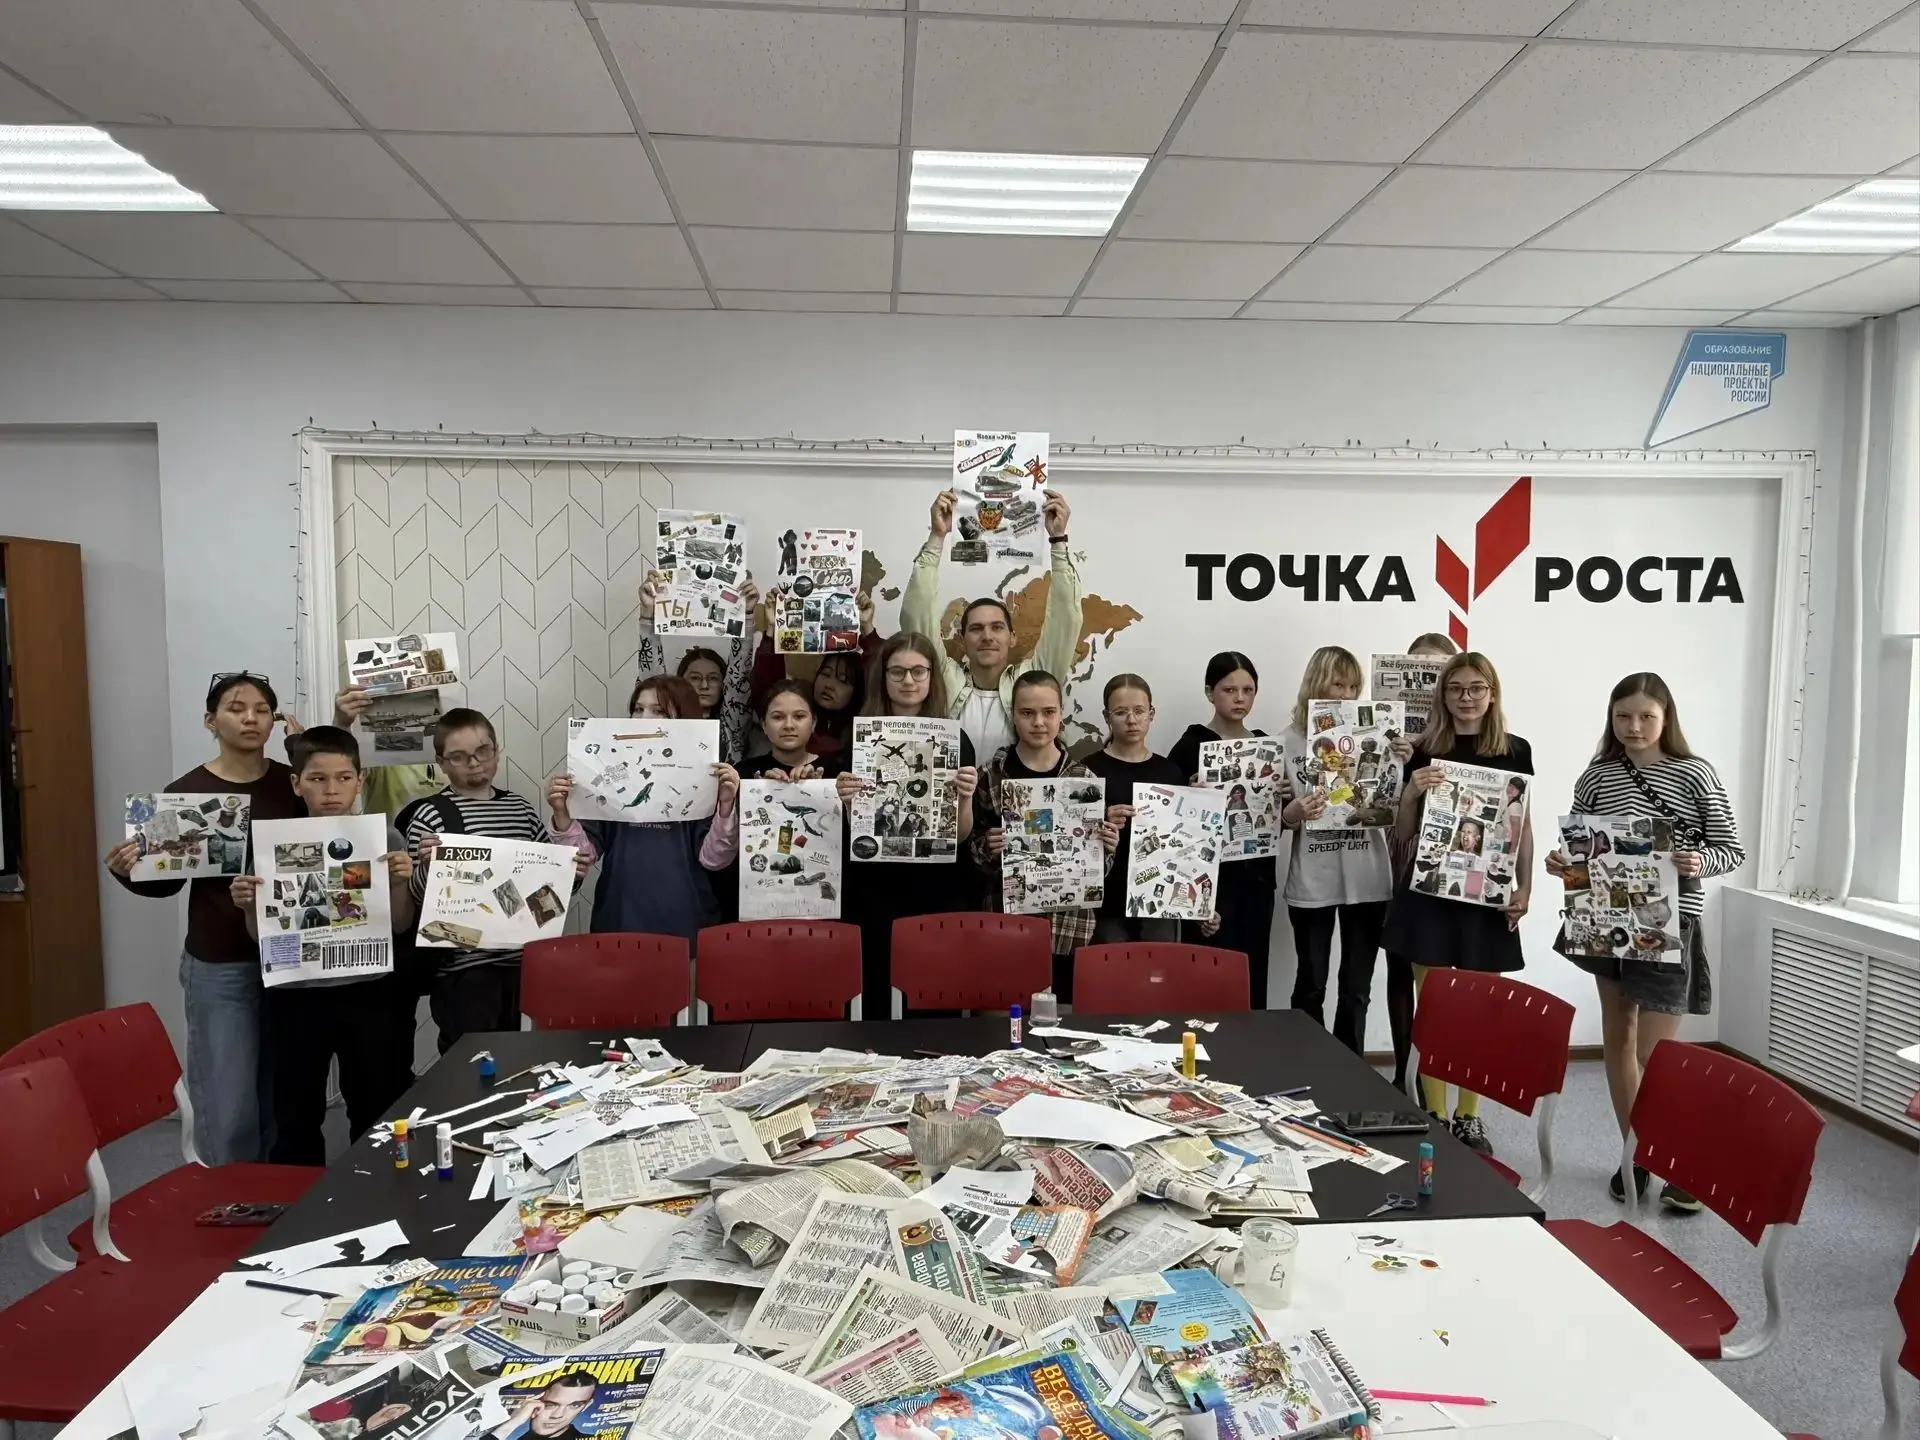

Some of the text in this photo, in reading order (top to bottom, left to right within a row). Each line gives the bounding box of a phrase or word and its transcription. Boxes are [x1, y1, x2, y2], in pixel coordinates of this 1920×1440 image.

[1704, 344, 1772, 355] ОБРАЗОВАНИЕ
[1691, 363, 1769, 377] НАЦИОНАЛЬНЫЕ
[1723, 377, 1768, 390] ПРОЕКТЫ
[1730, 390, 1767, 403] РОССИИ
[1185, 553, 1745, 603] ТОЧКА РОСТА
[444, 848, 491, 861] Я ХОЧУ
[508, 1318, 543, 1331] ГУАШЬ
[577, 1316, 587, 1326] 12
